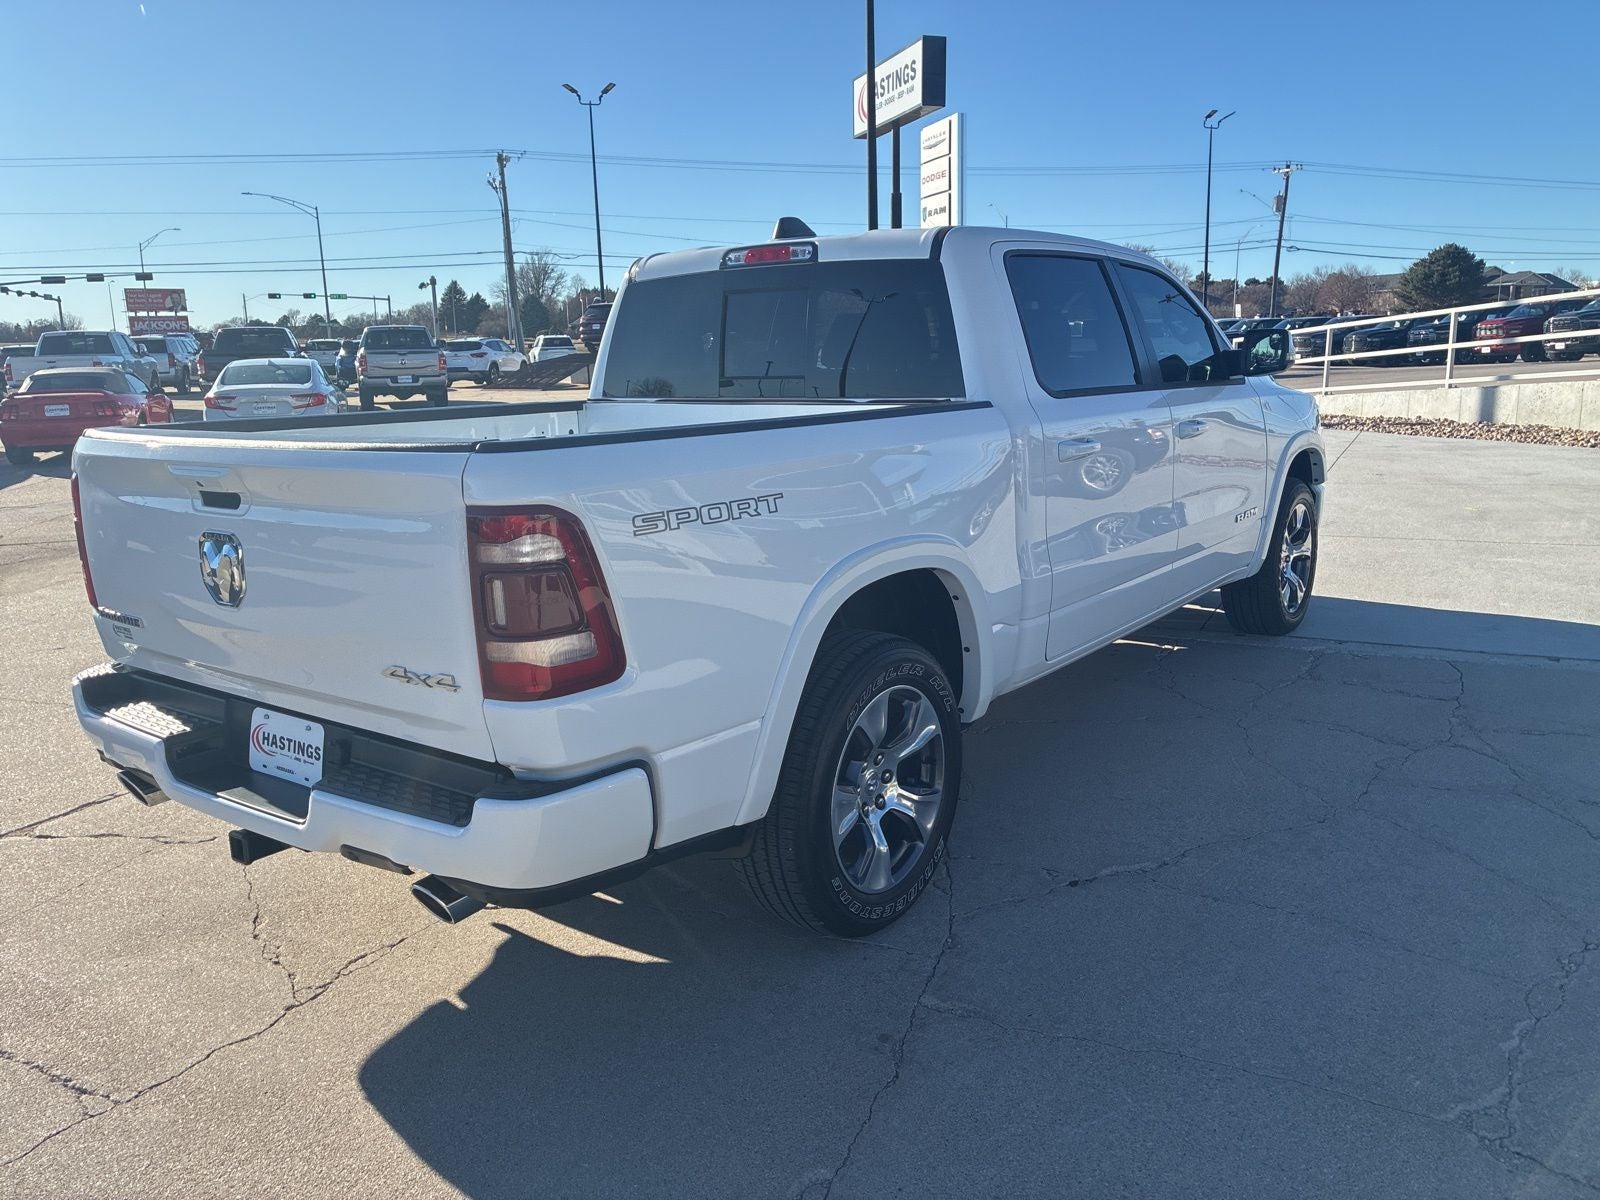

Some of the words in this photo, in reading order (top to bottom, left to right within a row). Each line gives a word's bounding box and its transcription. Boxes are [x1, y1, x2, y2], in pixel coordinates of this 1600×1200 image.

[875, 59, 917, 100] ASTINGS
[922, 169, 947, 185] DODGE
[928, 206, 947, 218] RAM
[133, 320, 188, 331] JACKSON'S
[632, 492, 784, 537] SPORT
[1234, 506, 1259, 524] RAM
[261, 730, 322, 762] HASTINGS
